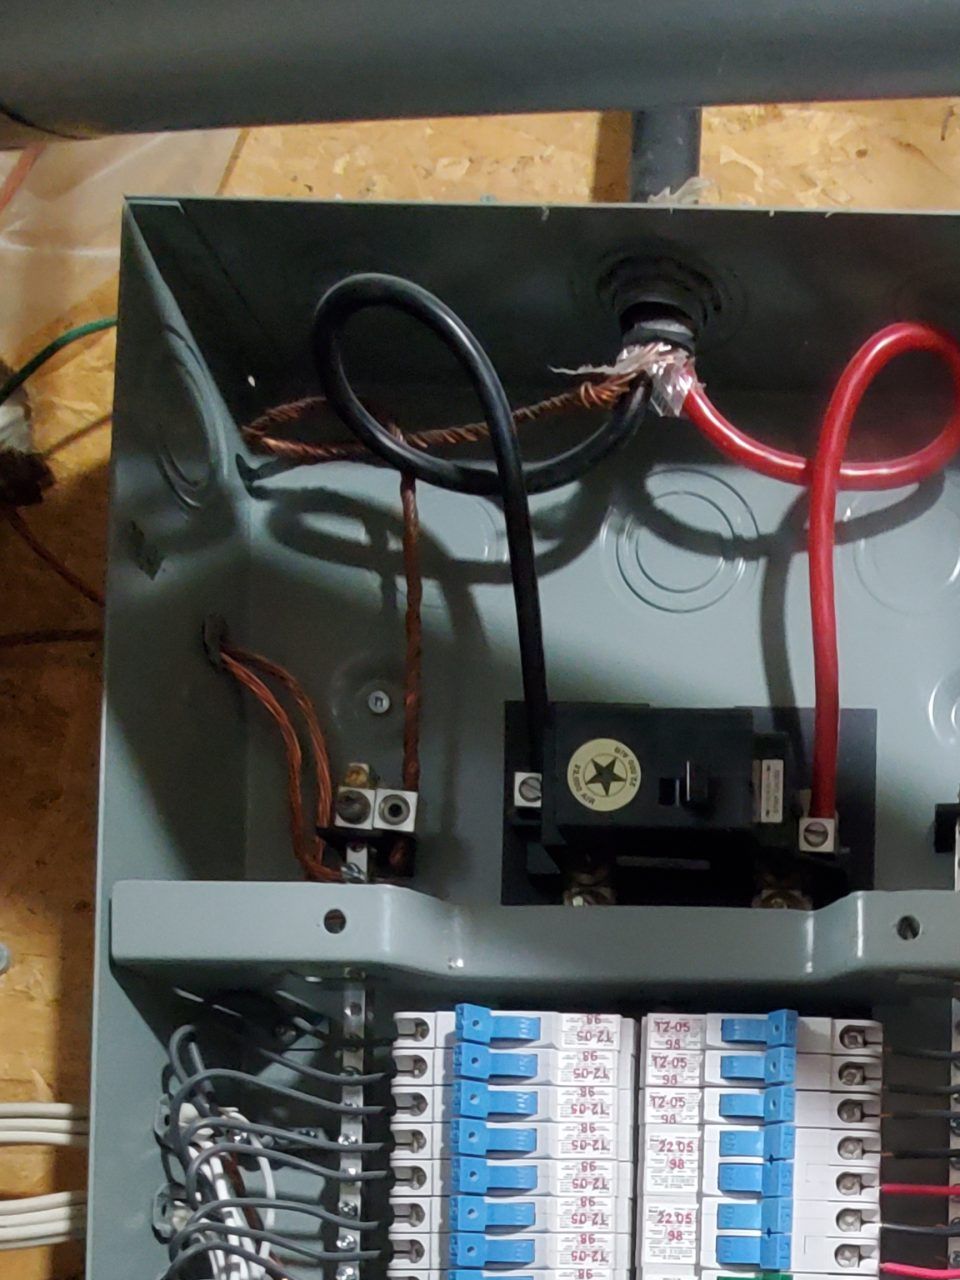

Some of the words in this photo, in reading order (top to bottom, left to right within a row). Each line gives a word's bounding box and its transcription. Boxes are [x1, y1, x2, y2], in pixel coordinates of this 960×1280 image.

[665, 1039, 681, 1049] 98
[662, 1074, 678, 1085] 98
[661, 1114, 676, 1124] 98
[669, 1158, 685, 1169] 98
[667, 1230, 683, 1241] 98
